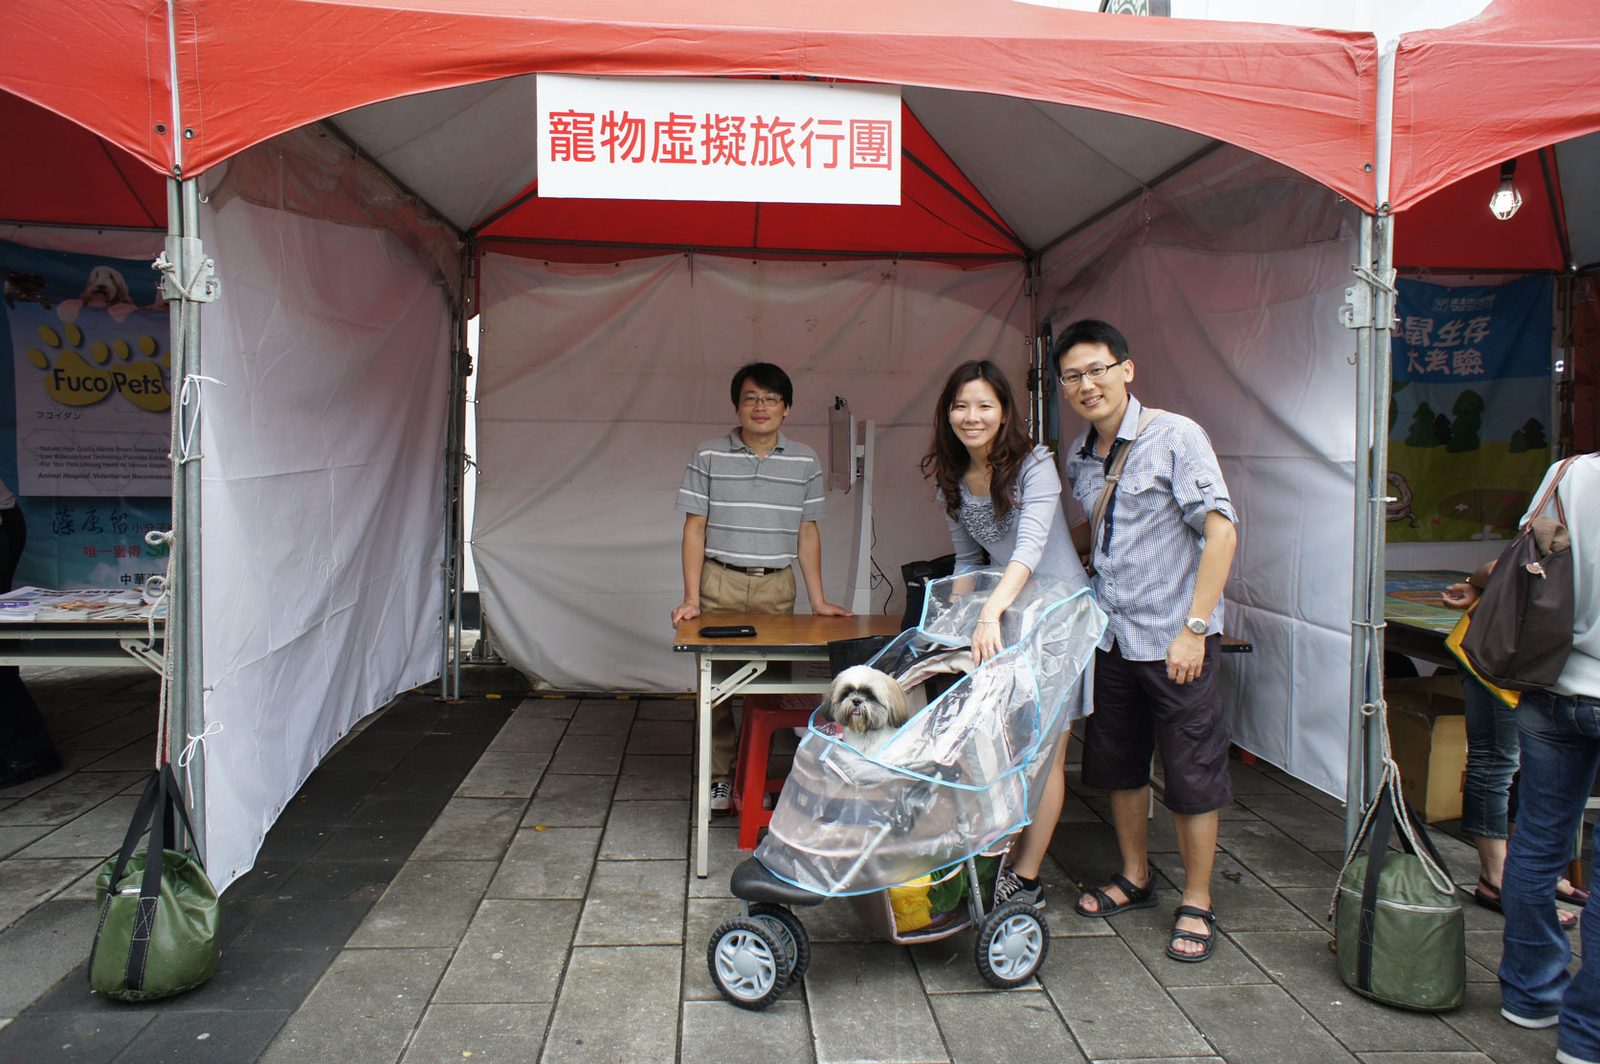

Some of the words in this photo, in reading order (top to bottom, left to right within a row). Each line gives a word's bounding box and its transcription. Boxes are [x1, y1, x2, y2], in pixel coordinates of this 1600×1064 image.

[548, 109, 893, 171] 寵物虛擬旅行團
[1392, 315, 1491, 347] 鼠生存
[1407, 347, 1485, 375] 大考驗
[53, 368, 108, 392] Fuco
[112, 371, 162, 395] Pets
[36, 411, 82, 421] フコイダン
[83, 544, 142, 558] 唯一獲得
